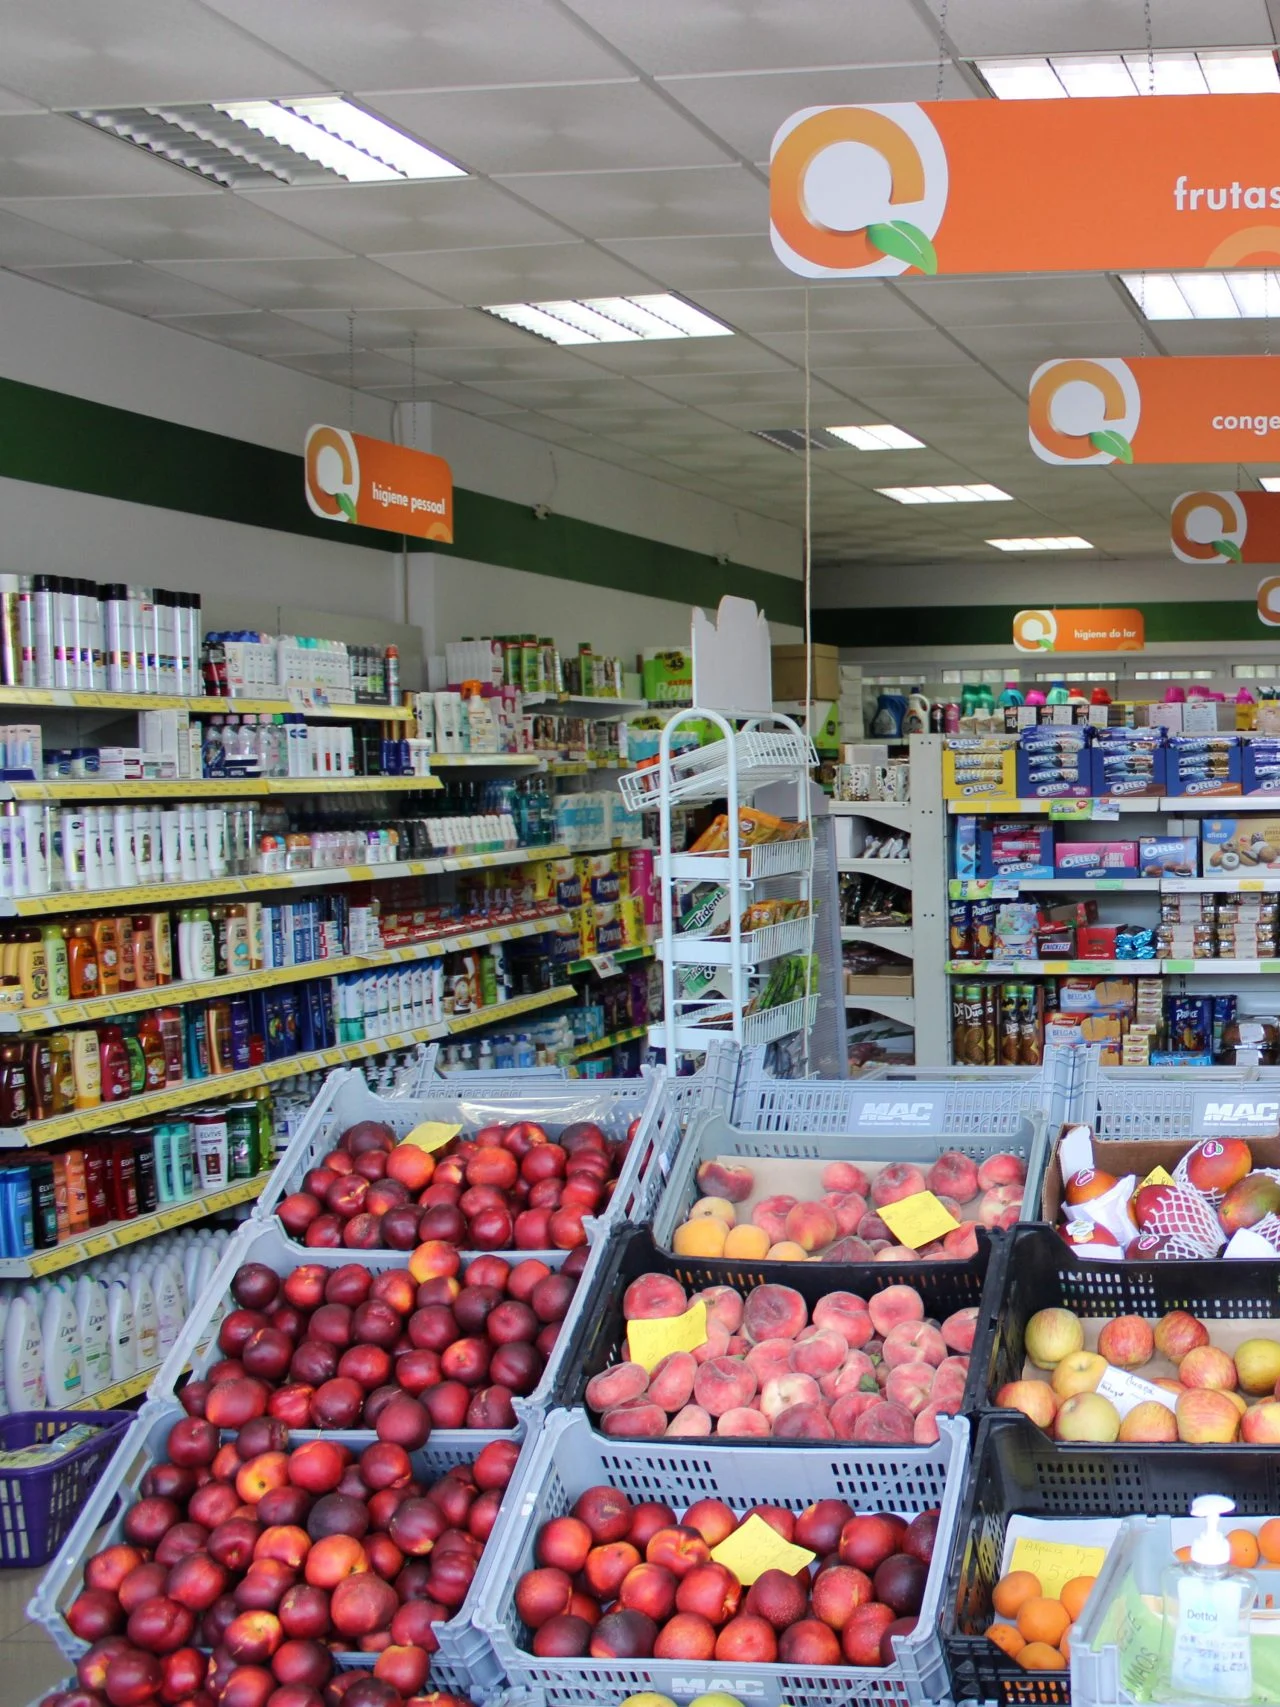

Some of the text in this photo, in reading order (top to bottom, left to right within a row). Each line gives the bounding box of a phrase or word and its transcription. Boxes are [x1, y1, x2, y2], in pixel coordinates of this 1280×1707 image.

[372, 481, 446, 515] higiene pessoal
[1073, 628, 1137, 640] higiene do lar
[655, 683, 692, 699] Ren
[961, 783, 997, 796] OREO
[1036, 783, 1070, 796] OREO
[1110, 781, 1147, 795] OREO
[1185, 780, 1223, 795] OREO
[1144, 842, 1185, 858] OREO
[1060, 853, 1100, 868] OREO
[999, 863, 1033, 875] OREO
[693, 889, 725, 926] Trident
[1042, 943, 1071, 951] SNICKERS
[1052, 1029, 1077, 1037] BELGAS
[859, 1103, 934, 1121] MAC
[1203, 1102, 1279, 1121] MAC
[200, 1130, 222, 1139] ELVIVE
[60, 1325, 78, 1338] Dove
[1187, 1608, 1218, 1622] Dettol
[671, 1677, 765, 1695] MAC
